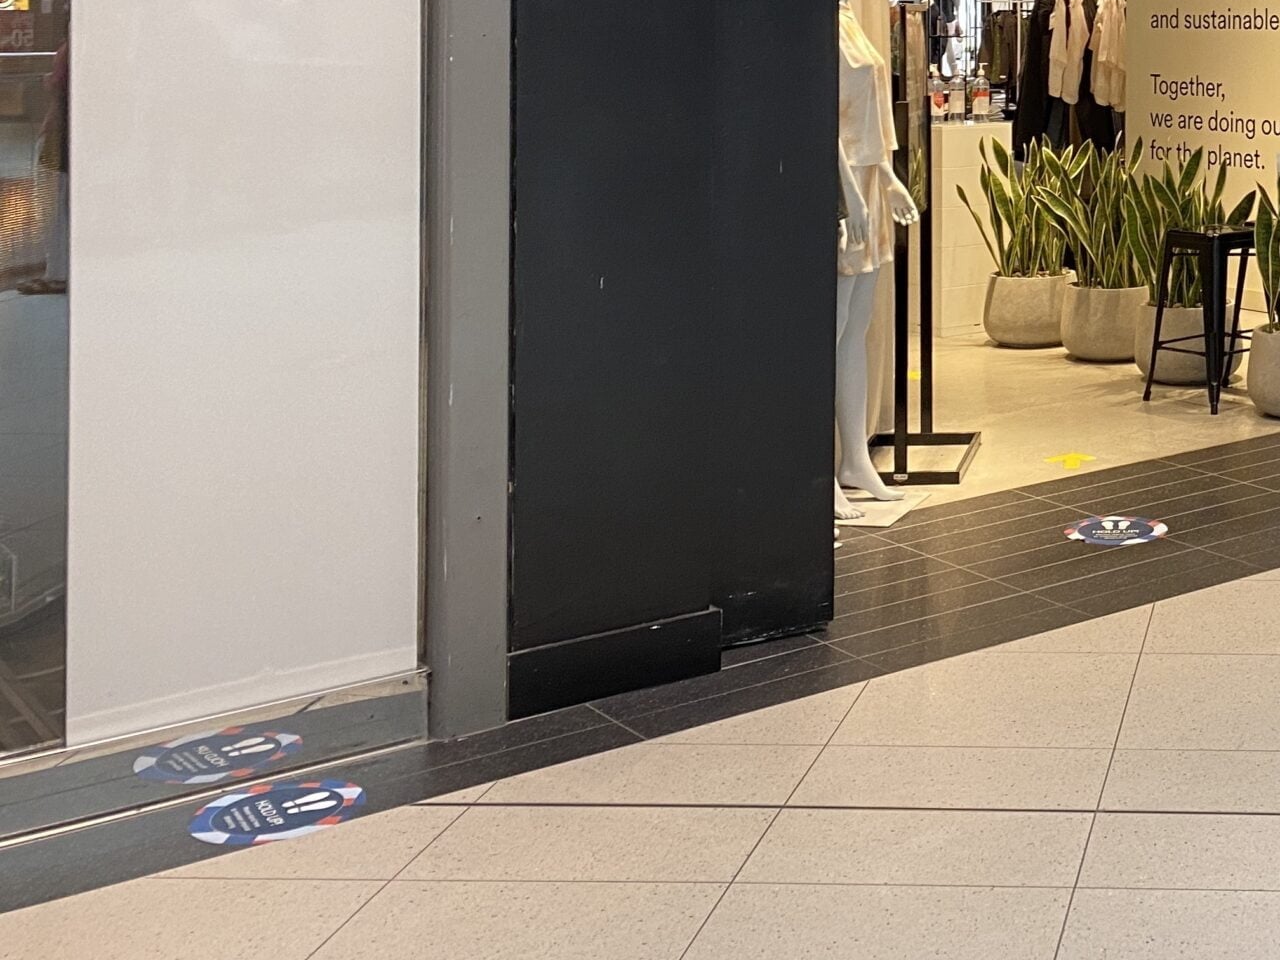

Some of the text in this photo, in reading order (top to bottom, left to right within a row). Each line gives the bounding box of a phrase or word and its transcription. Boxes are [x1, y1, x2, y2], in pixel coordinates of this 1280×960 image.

[1151, 8, 1179, 29] and
[1184, 8, 1279, 30] sustainable
[1150, 74, 1226, 102] Together,
[1150, 112, 1173, 128] we
[1178, 113, 1203, 130] are
[1208, 110, 1255, 139] doing
[1150, 139, 1265, 170] for th planet.
